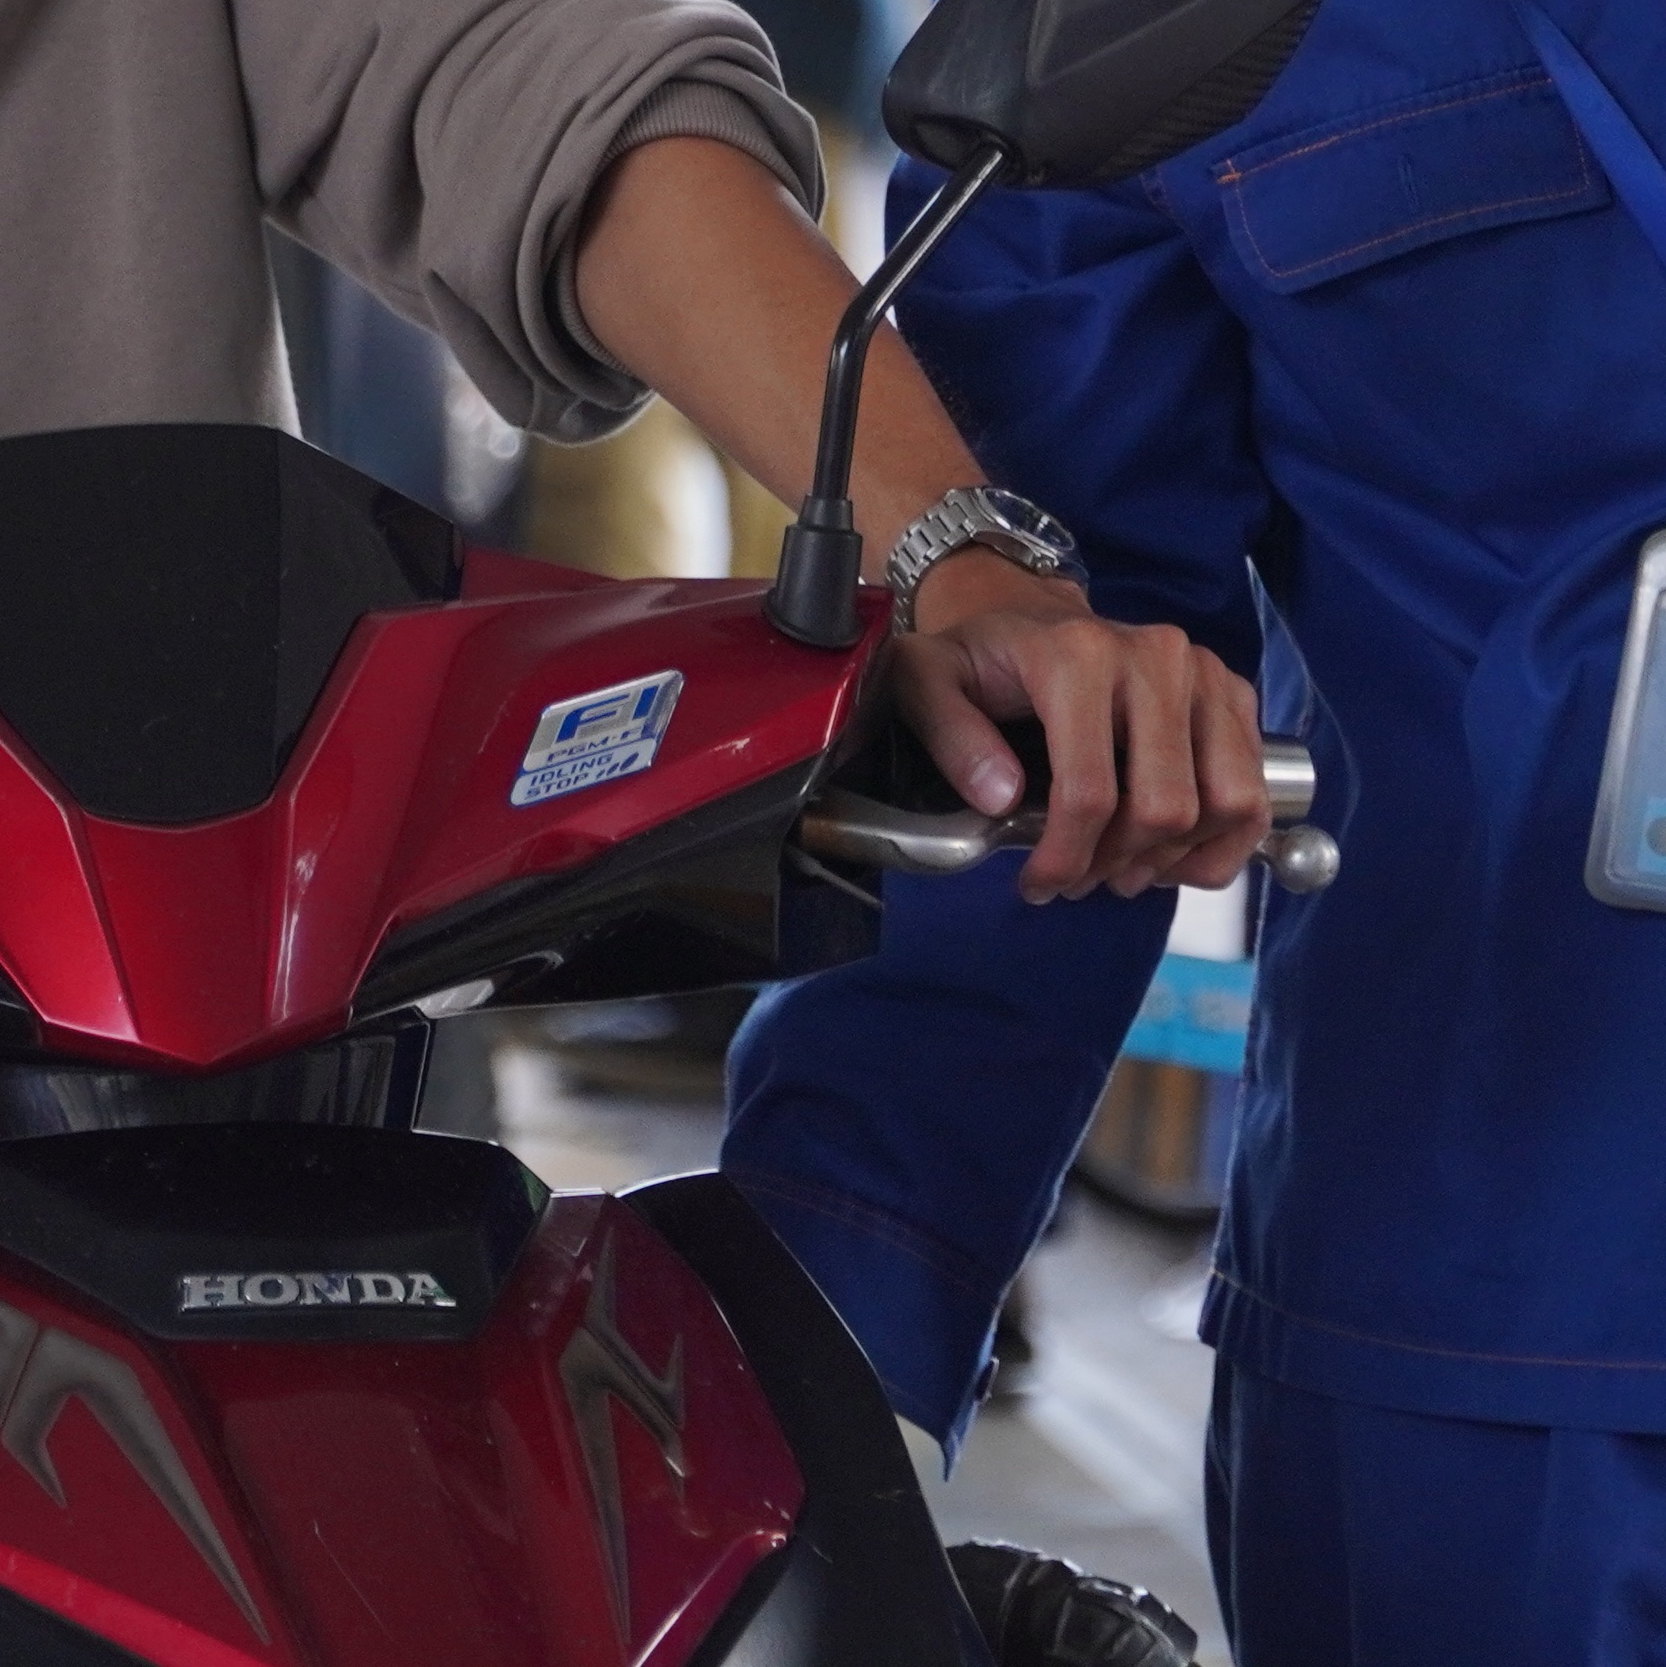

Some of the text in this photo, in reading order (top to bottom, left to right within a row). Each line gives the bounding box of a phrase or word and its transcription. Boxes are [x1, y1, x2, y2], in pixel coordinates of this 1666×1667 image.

[556, 686, 659, 743] FI
[546, 727, 644, 762] PGM-F
[526, 772, 589, 800] STOP
[530, 752, 614, 787] IDLING
[178, 1272, 456, 1312] HONDA
